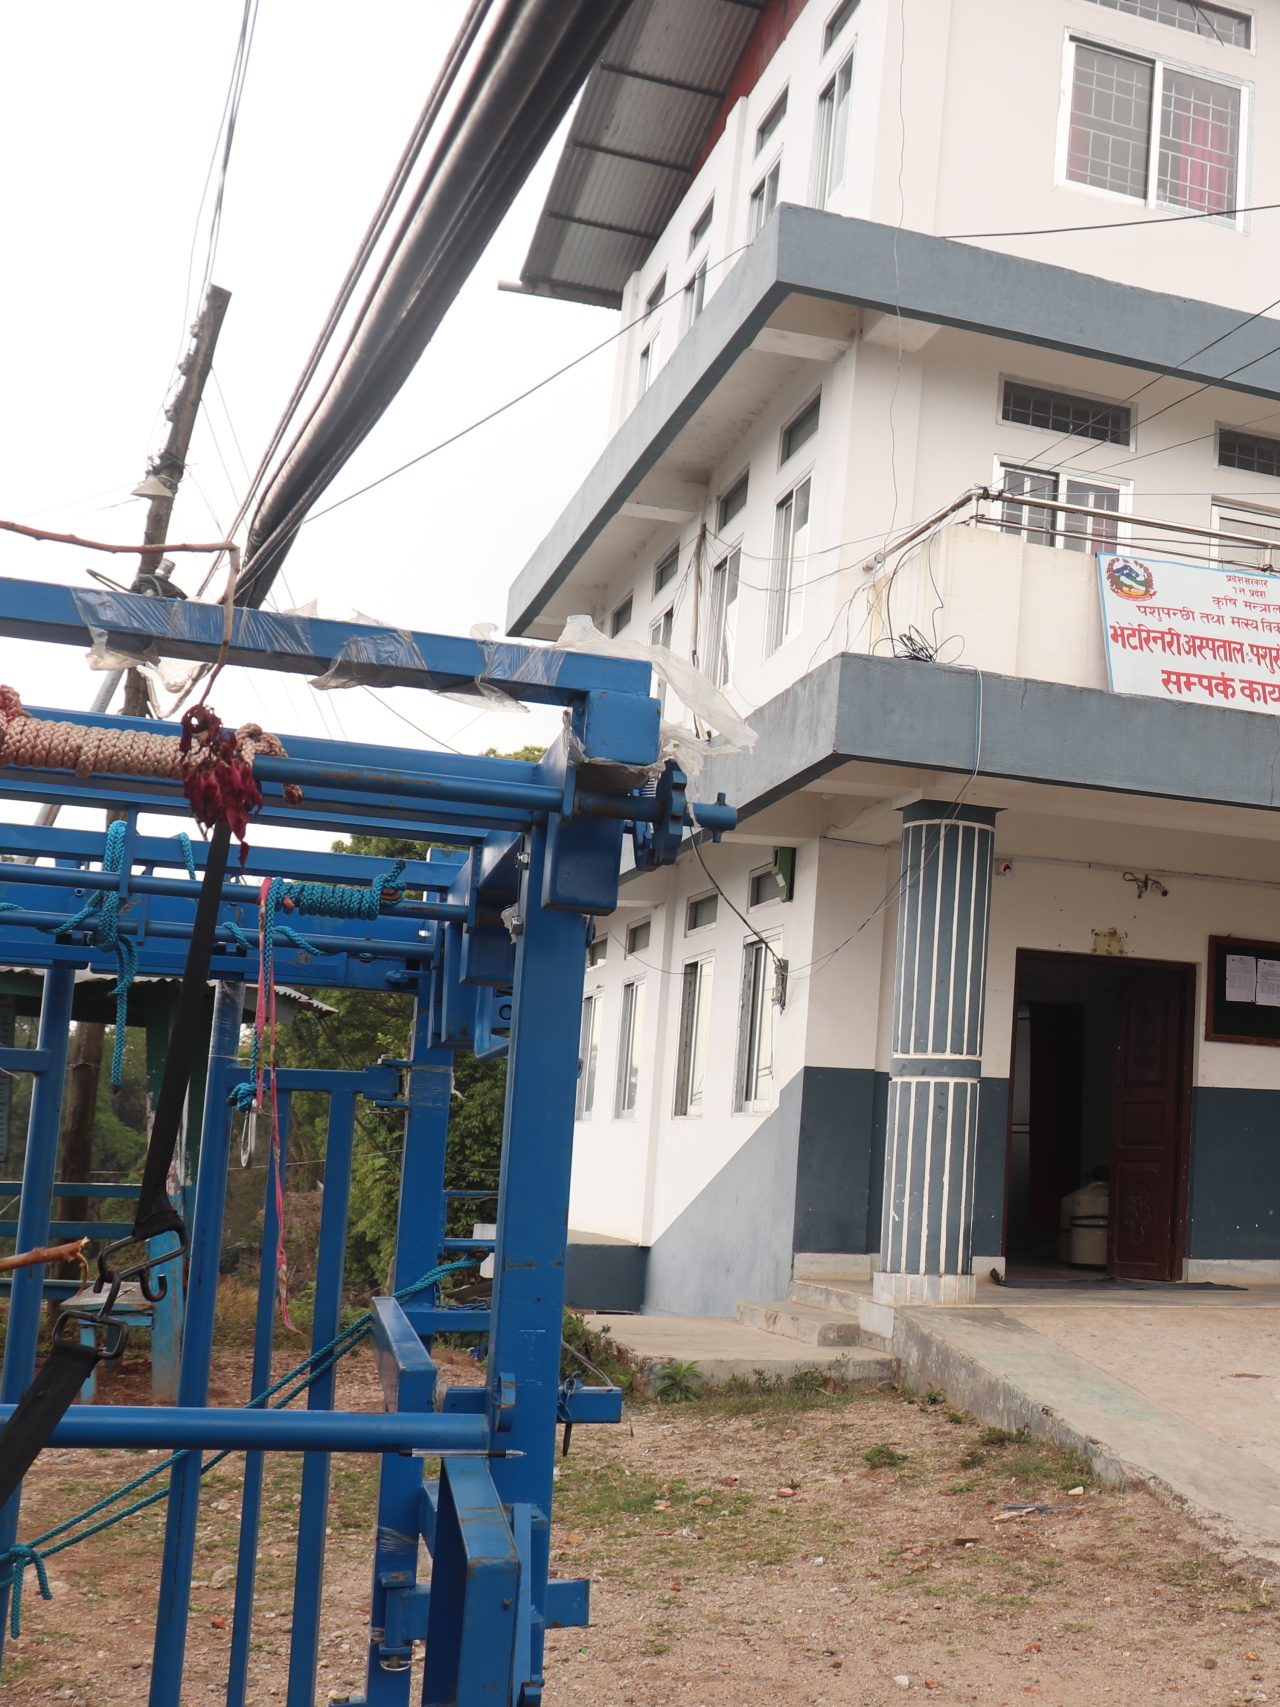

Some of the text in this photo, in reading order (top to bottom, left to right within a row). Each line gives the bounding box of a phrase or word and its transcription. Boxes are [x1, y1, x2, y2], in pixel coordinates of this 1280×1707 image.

[1212, 595, 1238, 609] कृषि
[1136, 605, 1195, 622] पशुपन्छी
[1199, 612, 1225, 626] तथा
[1230, 616, 1259, 632] मत्स्य
[1110, 621, 1182, 656] भेटेरिनरी
[1182, 634, 1246, 664] अस्पताल
[1161, 669, 1236, 701] सम्पर्क
